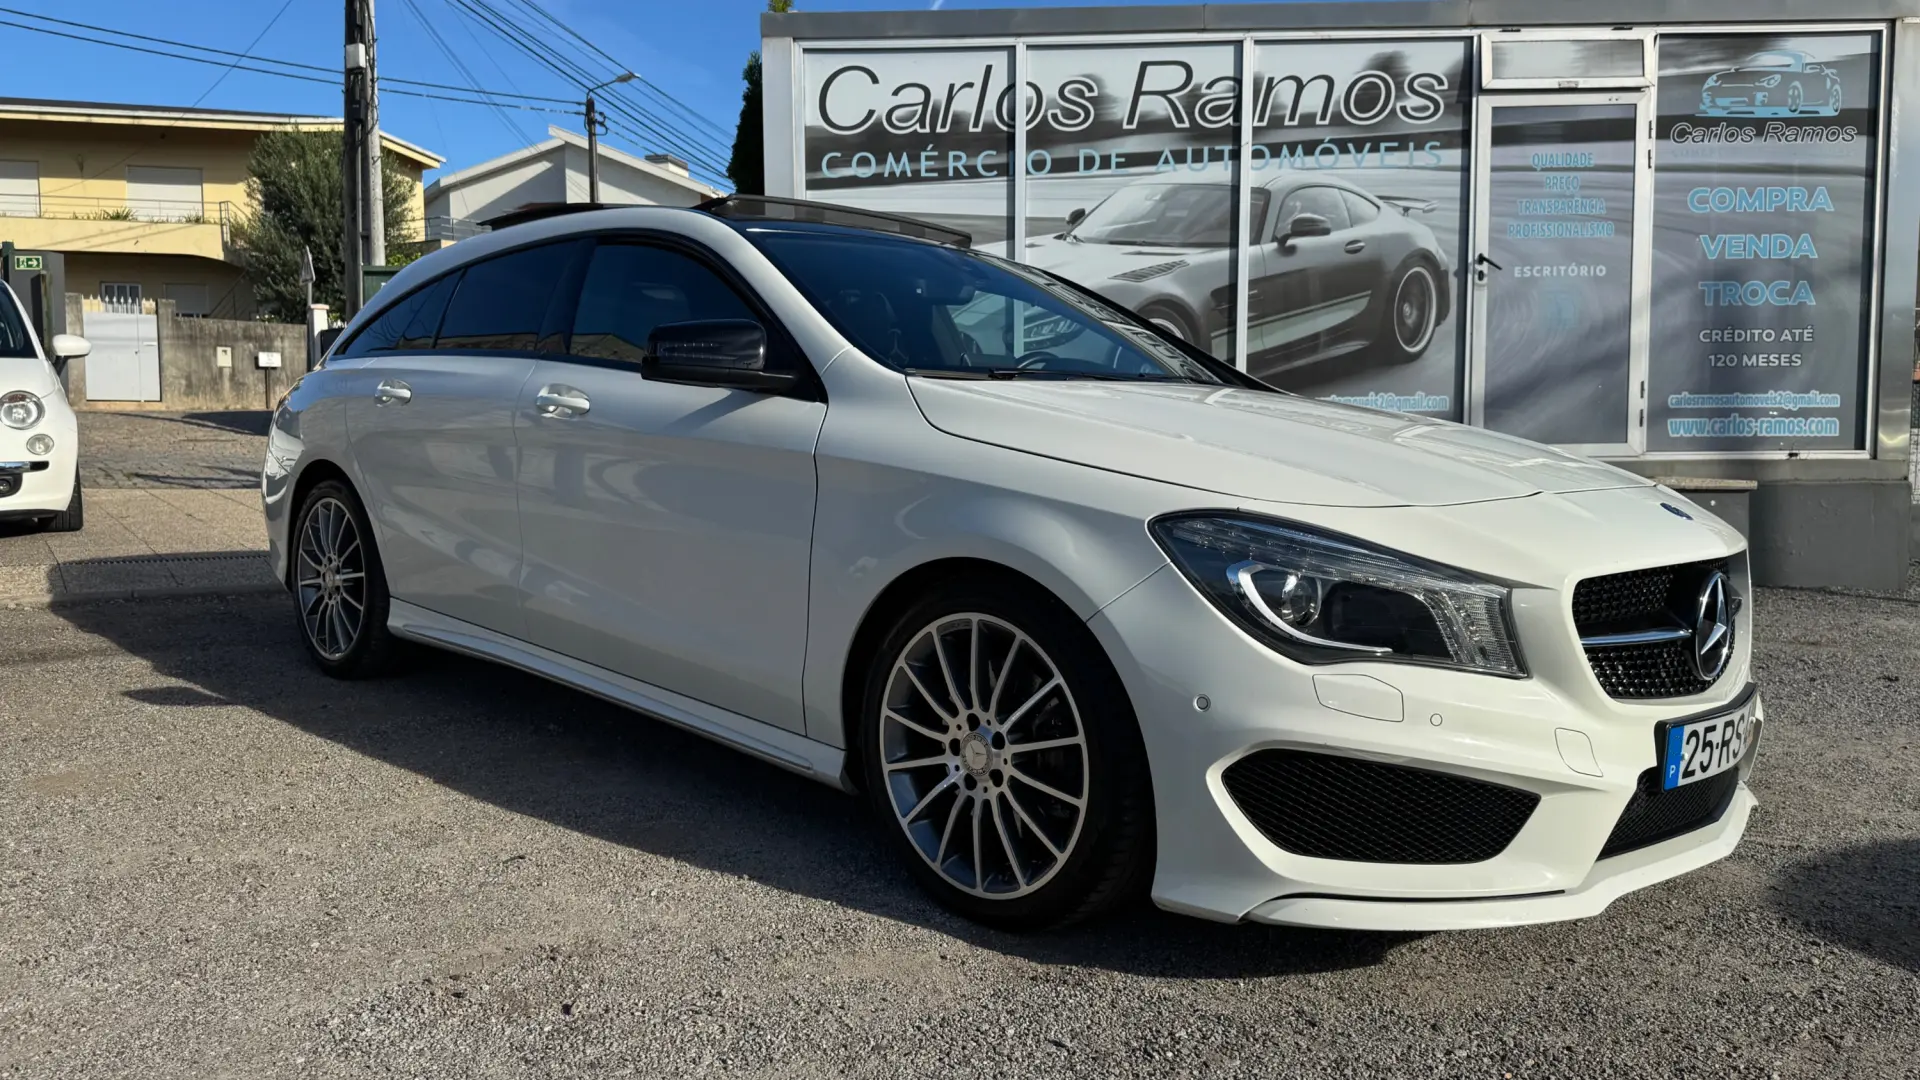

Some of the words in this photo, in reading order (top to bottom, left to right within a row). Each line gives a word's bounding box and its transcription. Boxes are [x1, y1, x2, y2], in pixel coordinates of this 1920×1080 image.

[818, 64, 1098, 135] Carlos
[1122, 60, 1449, 129] Ramos
[1671, 122, 1756, 144] Carlos
[1763, 121, 1857, 144] Ramos
[821, 144, 1052, 178] COMÉRCIO
[1078, 148, 1129, 175] DE
[1155, 137, 1442, 172] AUTOMÓVEIS
[1532, 152, 1594, 171] QUALIDADE
[1545, 175, 1580, 193] PREÇO
[1517, 195, 1606, 215] TRANSPARÊNCIA
[1687, 186, 1834, 213] COMPRA
[1507, 221, 1615, 238] PROFISSIONALISMO
[1699, 233, 1818, 260] VENDA
[1514, 262, 1607, 277] ESCRITÓRIO
[1698, 280, 1816, 306] TROCA
[1699, 326, 1776, 342] CRÉDITO
[1780, 325, 1814, 342] ATÉ
[1709, 354, 1738, 367] 120
[1742, 354, 1802, 367] MESES
[1668, 391, 1840, 411] carlosramosautomoveis2@gmail.com
[1668, 413, 1840, 437] www.carlos-ramos.com
[1669, 764, 1676, 778] P
